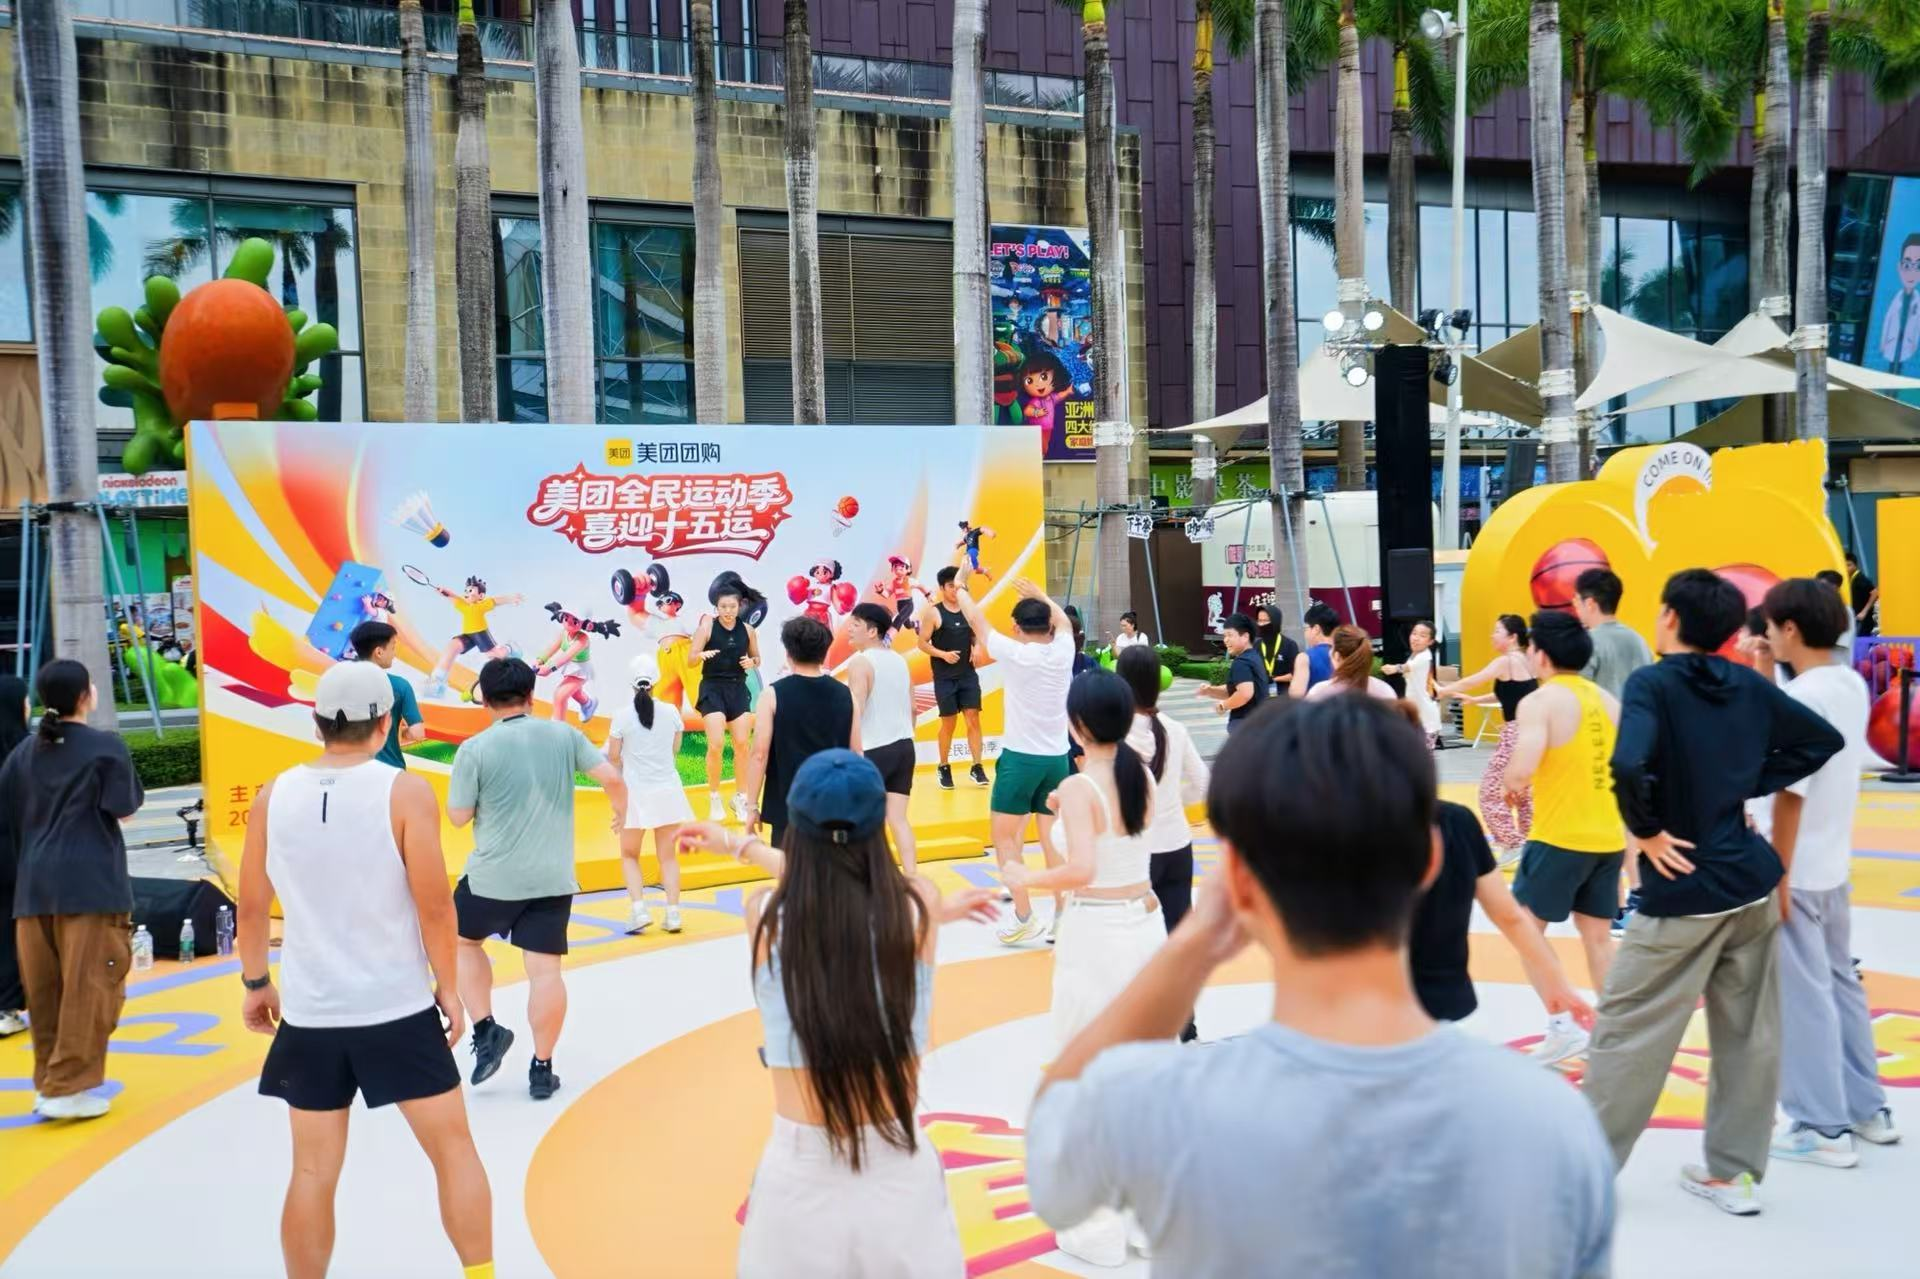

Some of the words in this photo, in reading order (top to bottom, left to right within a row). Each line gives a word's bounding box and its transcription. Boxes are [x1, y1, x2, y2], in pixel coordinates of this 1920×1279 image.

[990, 243, 1024, 257] ET'S
[1027, 244, 1070, 259] PLAY!
[1065, 401, 1094, 418] 亚洲
[608, 447, 631, 459] 美团
[637, 442, 721, 464] 美团团购
[1643, 450, 1680, 488] COME
[1683, 450, 1704, 471] ON
[532, 478, 787, 520] 美团全民运动季
[581, 511, 771, 551] 喜迎十五运
